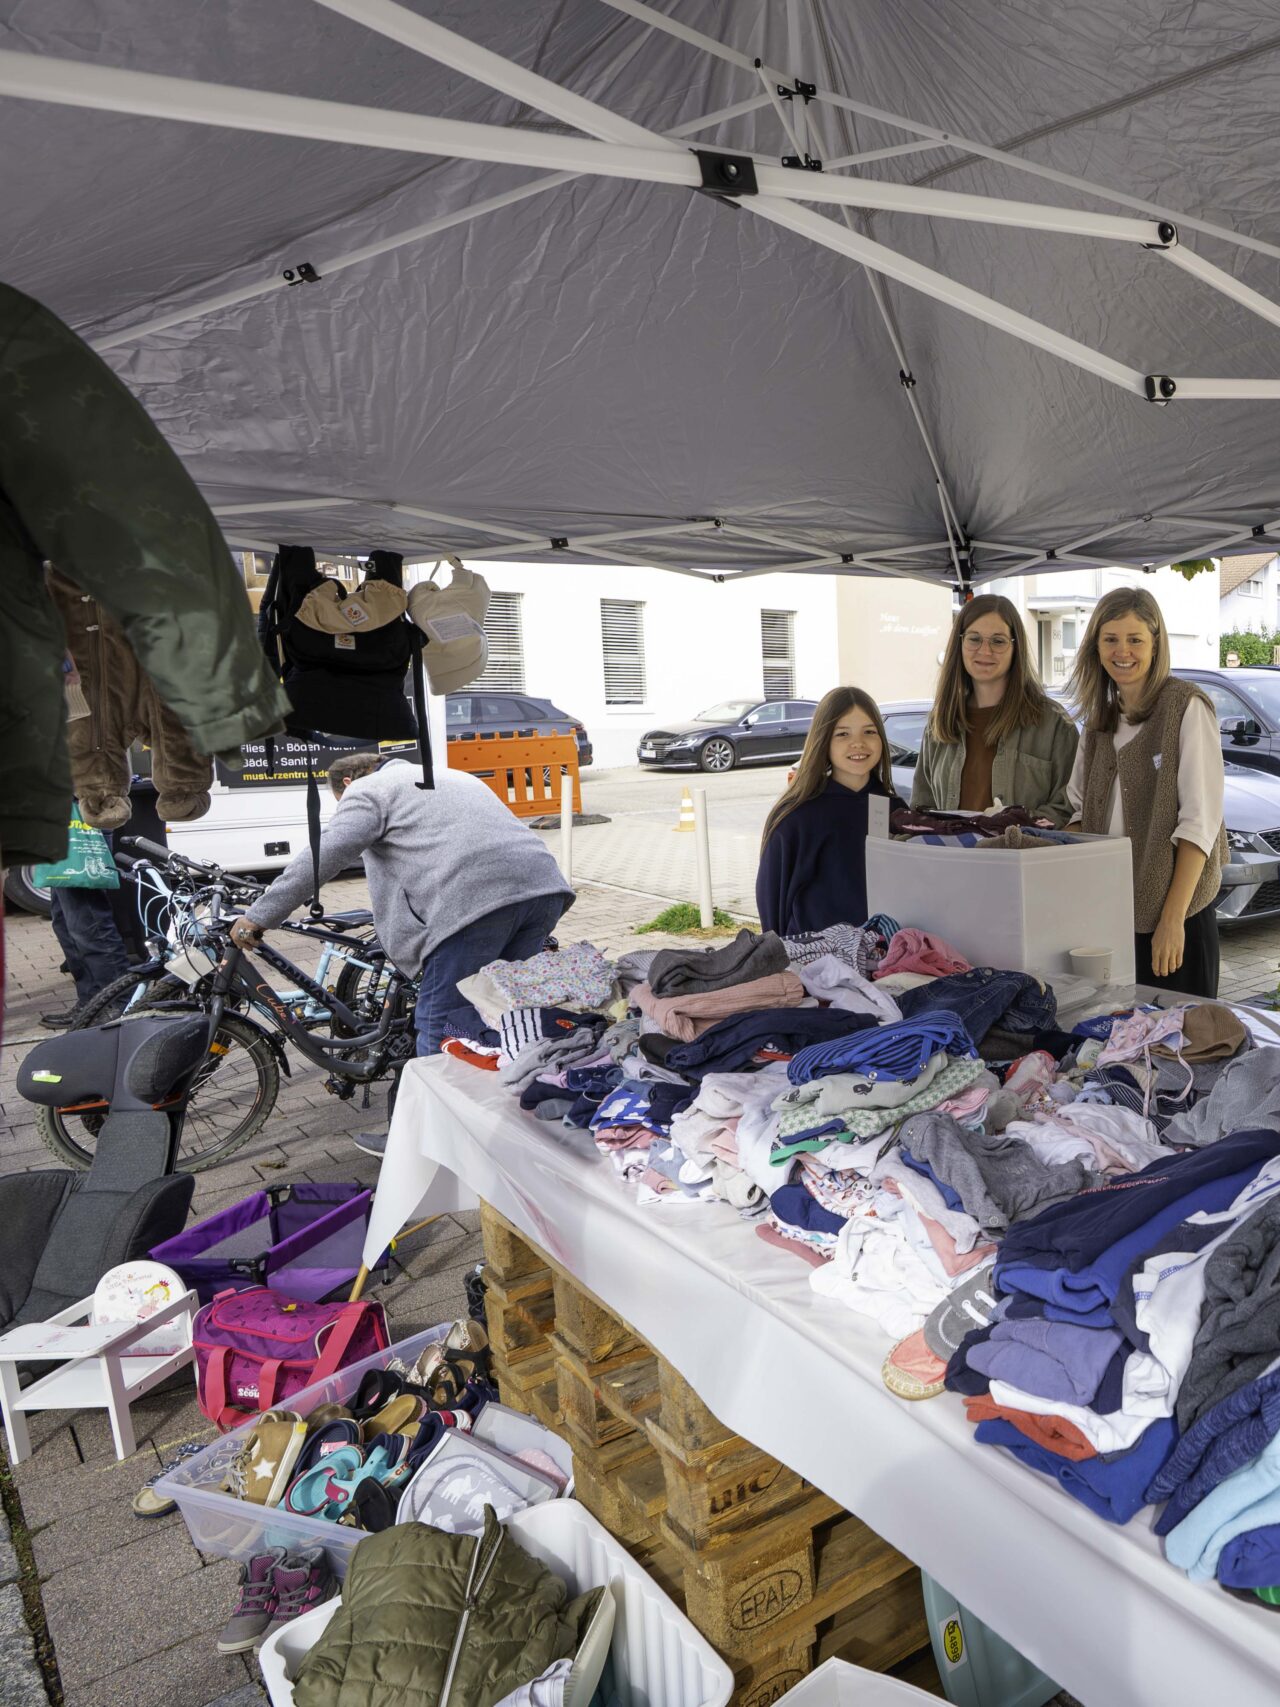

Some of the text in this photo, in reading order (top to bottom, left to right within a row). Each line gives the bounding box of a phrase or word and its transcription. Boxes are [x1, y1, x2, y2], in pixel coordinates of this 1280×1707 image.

[241, 743, 279, 753] Fliesn
[243, 757, 318, 768] Bäde Sanitr
[740, 1579, 793, 1625] EPAL
